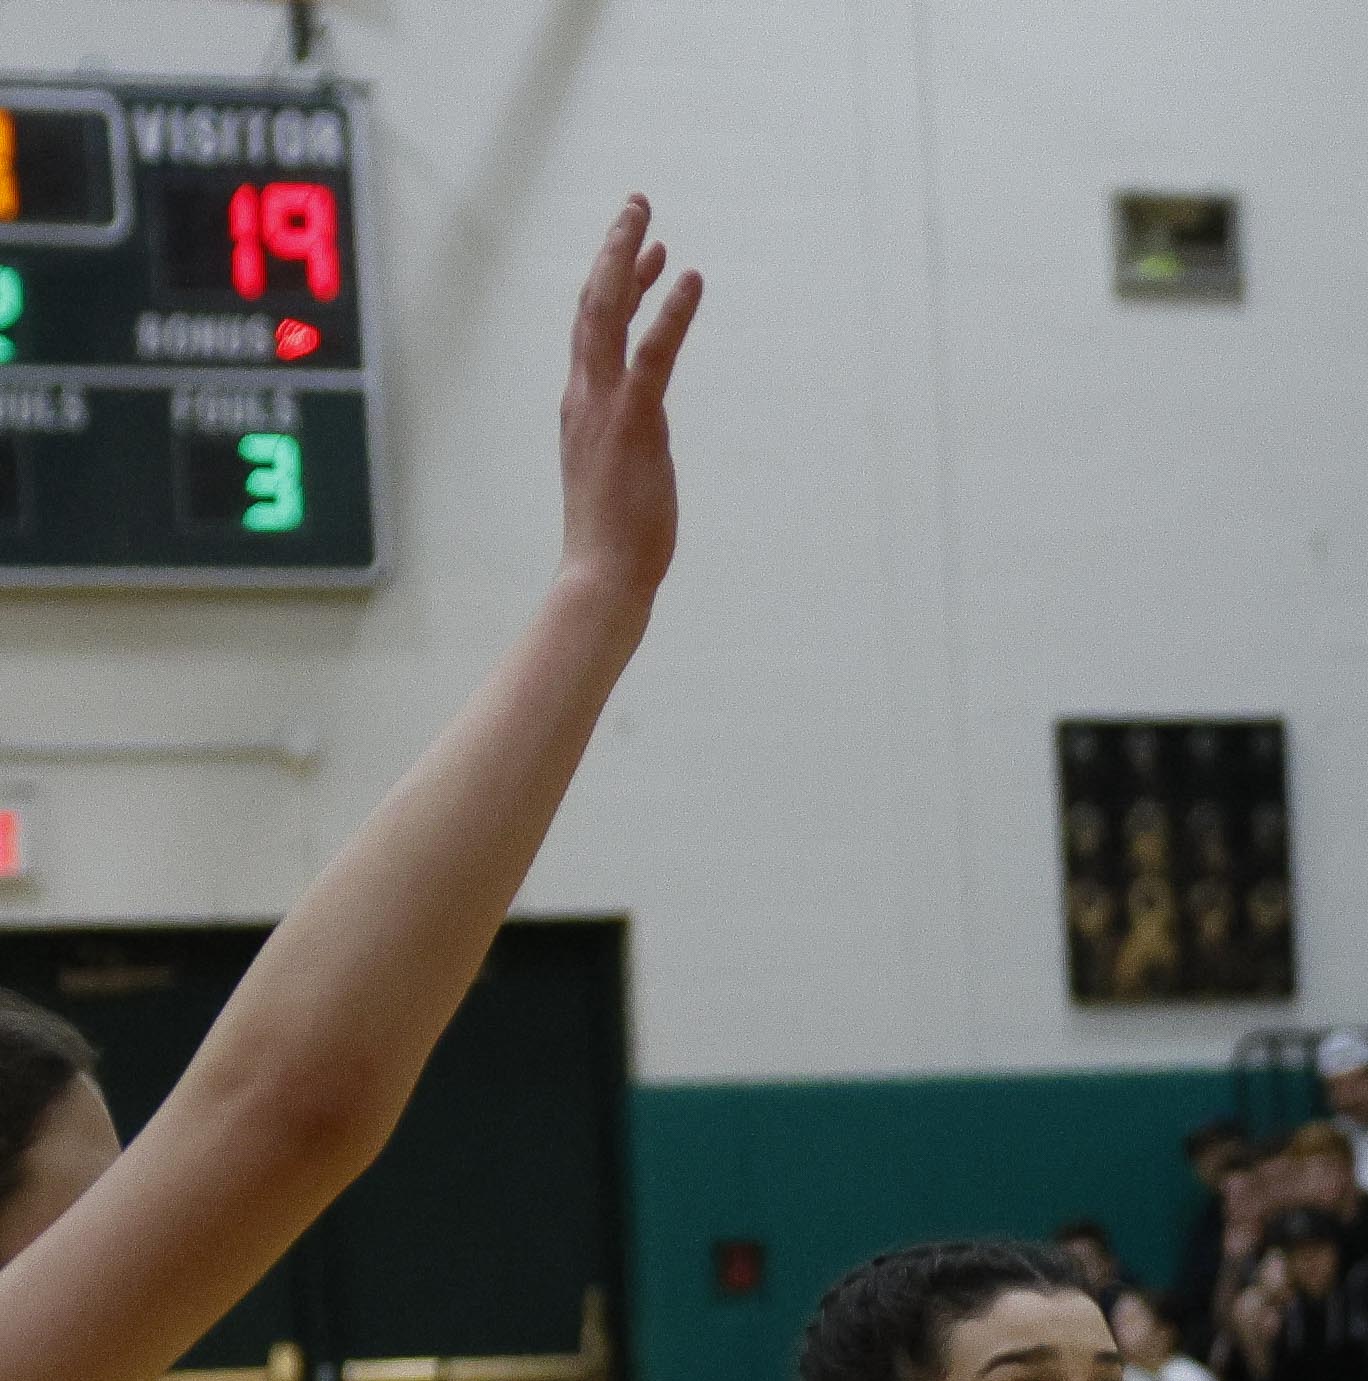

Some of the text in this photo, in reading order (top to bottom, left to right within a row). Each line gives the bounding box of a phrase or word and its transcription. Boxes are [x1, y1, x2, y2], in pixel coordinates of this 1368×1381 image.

[132, 103, 346, 168] VISITOR
[229, 182, 341, 301] 19
[236, 433, 305, 532] 3
